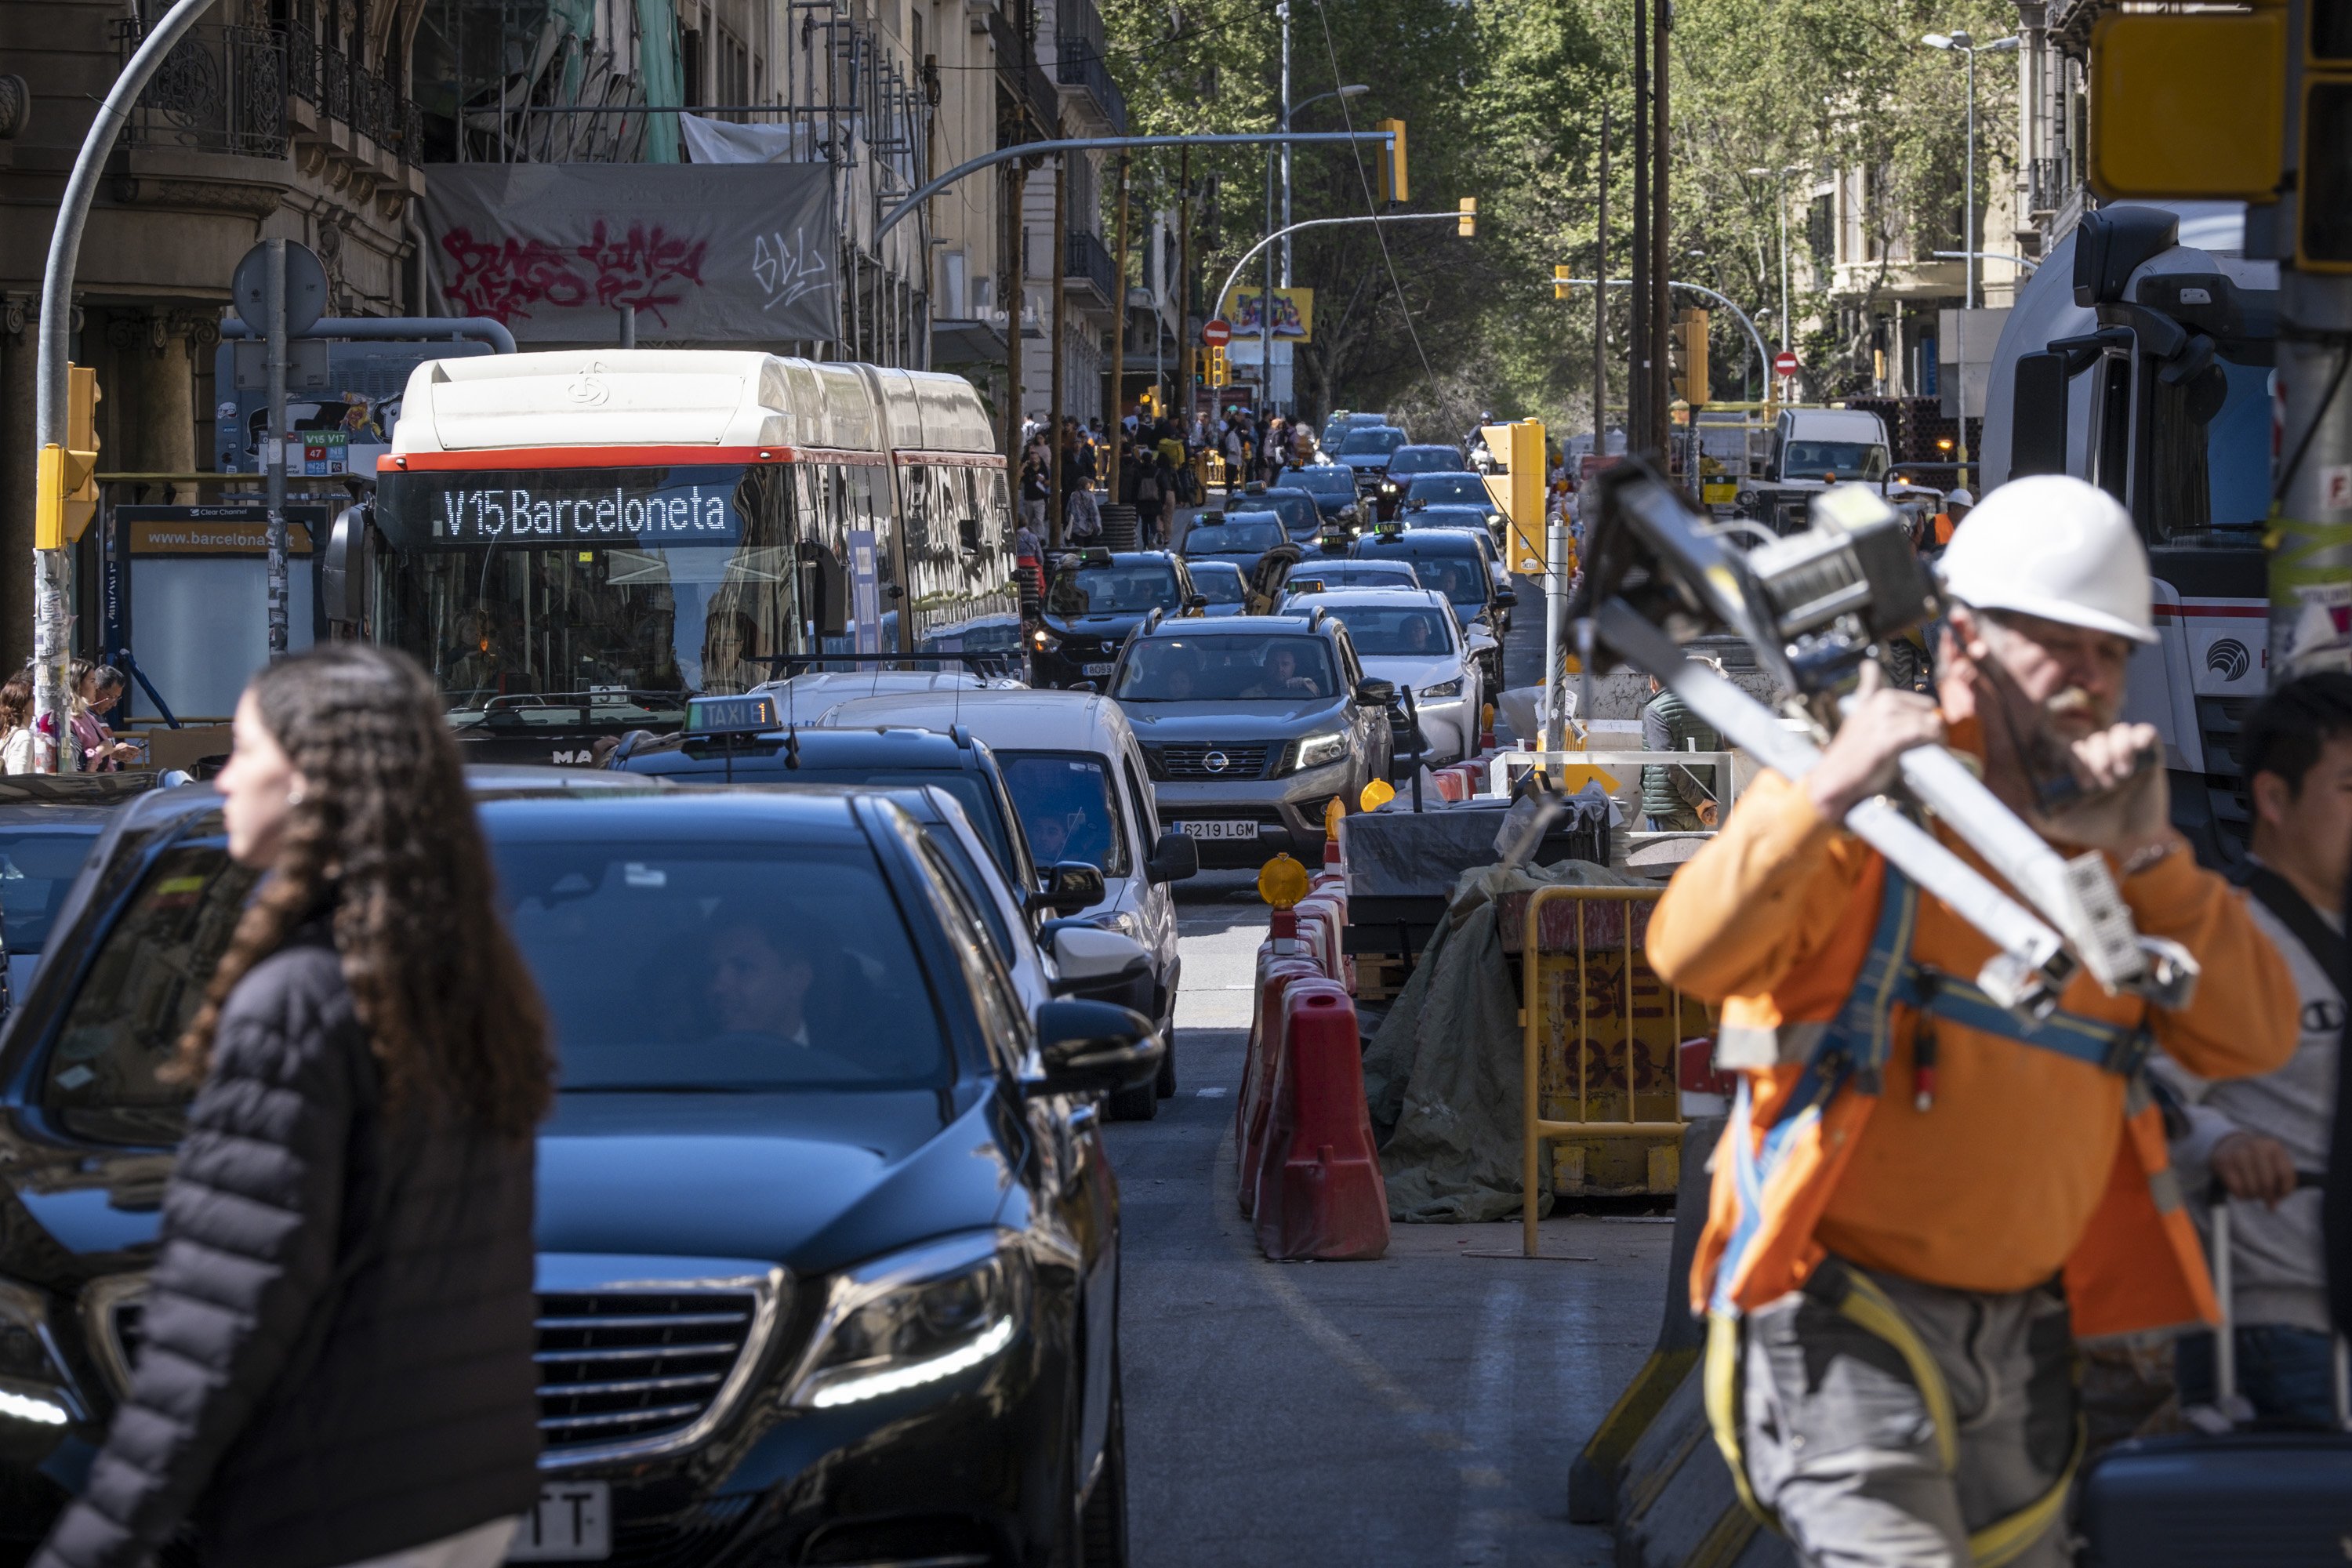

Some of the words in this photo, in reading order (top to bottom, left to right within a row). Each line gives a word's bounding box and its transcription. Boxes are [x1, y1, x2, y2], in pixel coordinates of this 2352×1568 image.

[306, 435, 325, 444] V15
[328, 434, 345, 443] V17
[309, 449, 322, 458] 47
[445, 490, 504, 535] V15
[512, 486, 725, 534] Barceloneta
[706, 704, 745, 727] TAXI
[553, 750, 592, 764] MA
[1184, 823, 1221, 837] 6219
[1226, 823, 1255, 837] LGM
[524, 1493, 591, 1547] TT
